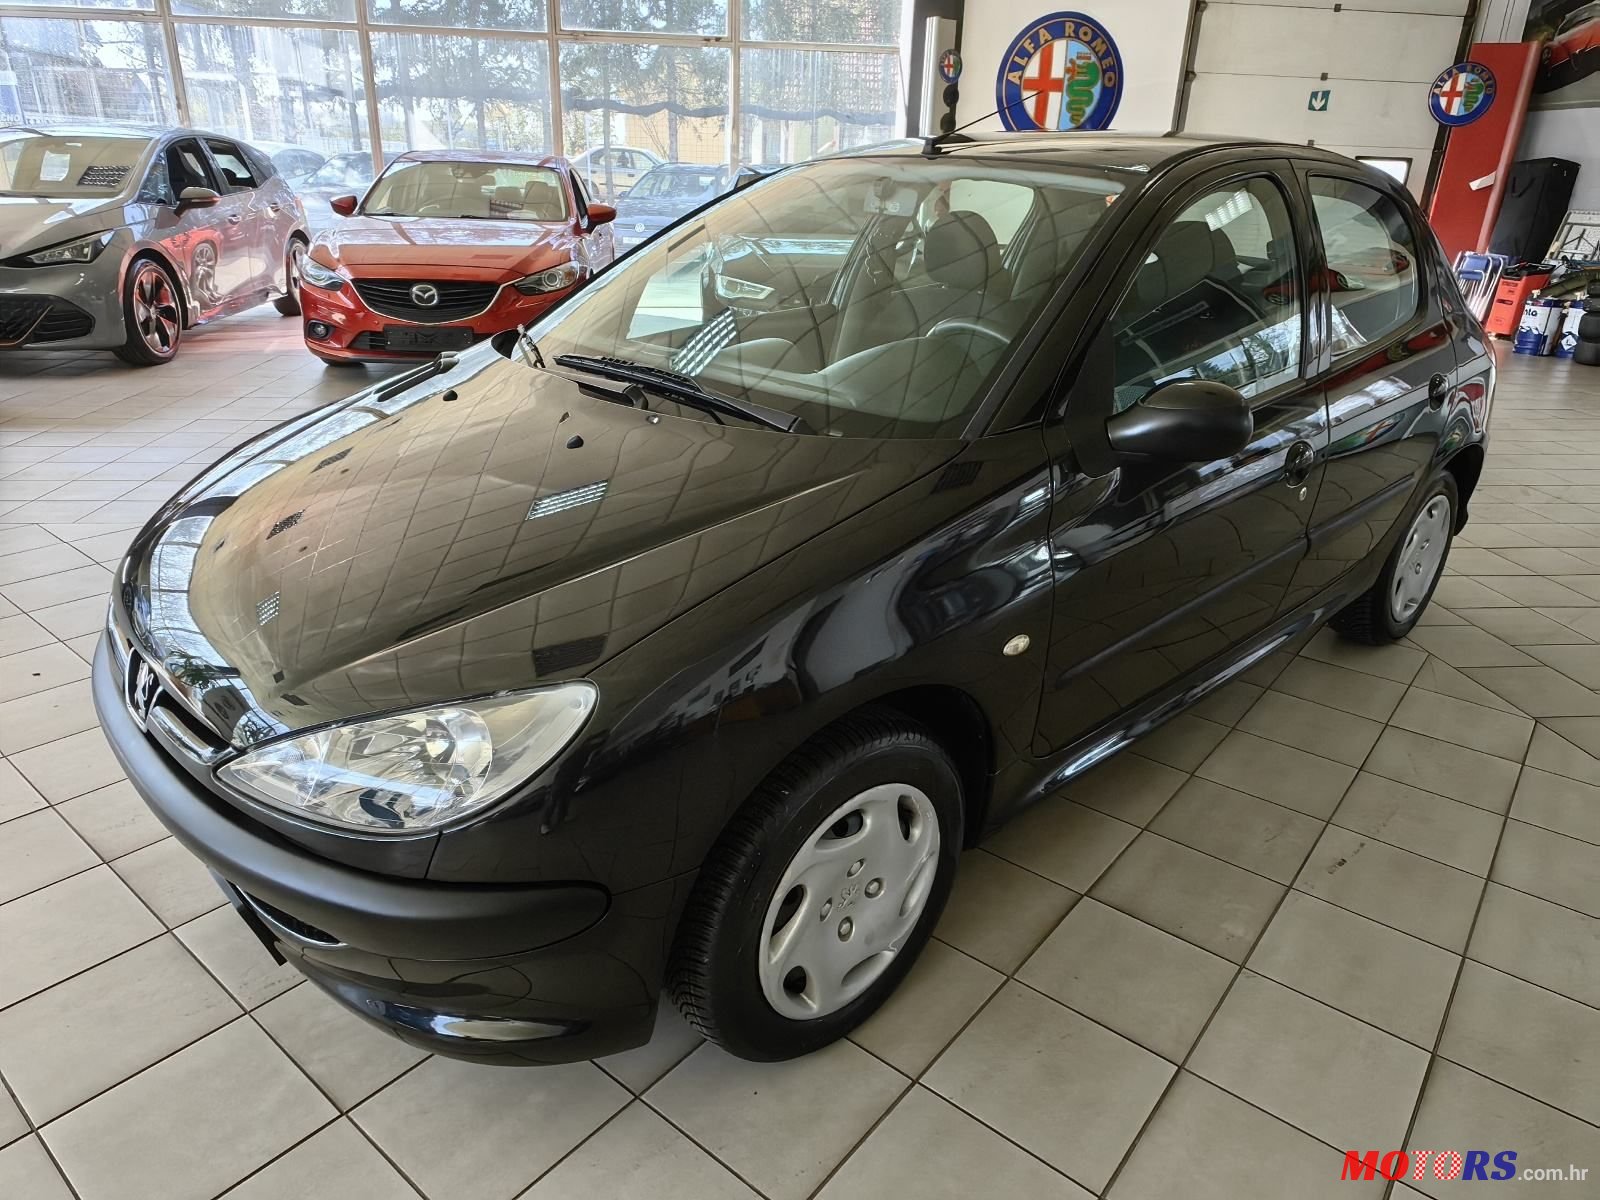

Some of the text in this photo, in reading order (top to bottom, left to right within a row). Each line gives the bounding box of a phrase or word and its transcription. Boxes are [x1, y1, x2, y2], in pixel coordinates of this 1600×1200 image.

[1007, 21, 1116, 88] ALFA ROMEO
[1433, 67, 1460, 94] ALFA
